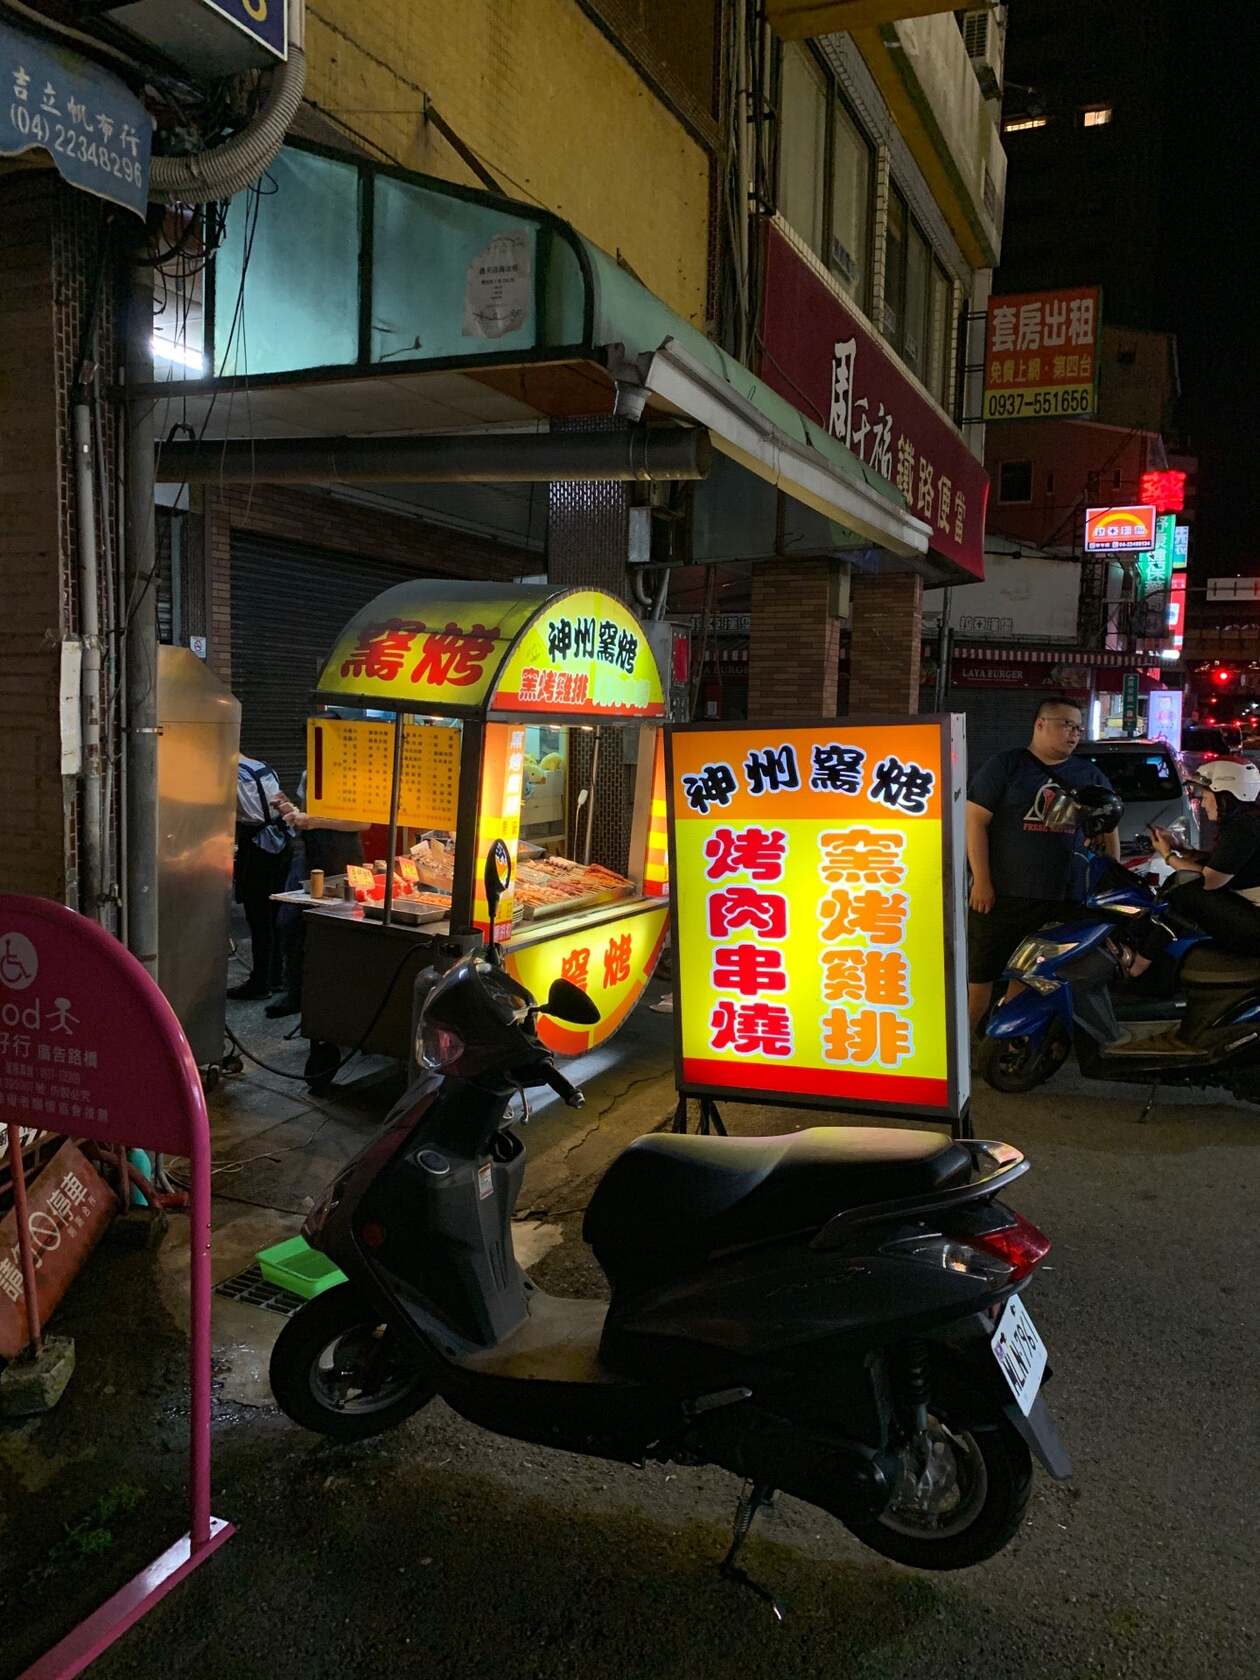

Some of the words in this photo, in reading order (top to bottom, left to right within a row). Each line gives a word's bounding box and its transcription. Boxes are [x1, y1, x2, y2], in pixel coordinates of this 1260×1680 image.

[991, 299, 1094, 352] 套房出租
[988, 389, 1089, 416] 0937-551656
[340, 618, 501, 686] 窯烤
[548, 617, 638, 675] 神州窯烤
[519, 668, 589, 704] 窯烤雞排
[683, 743, 935, 813] 神州窯烤
[704, 827, 792, 1056] 烤肉串燒
[818, 827, 912, 1066] 窯烤雞排
